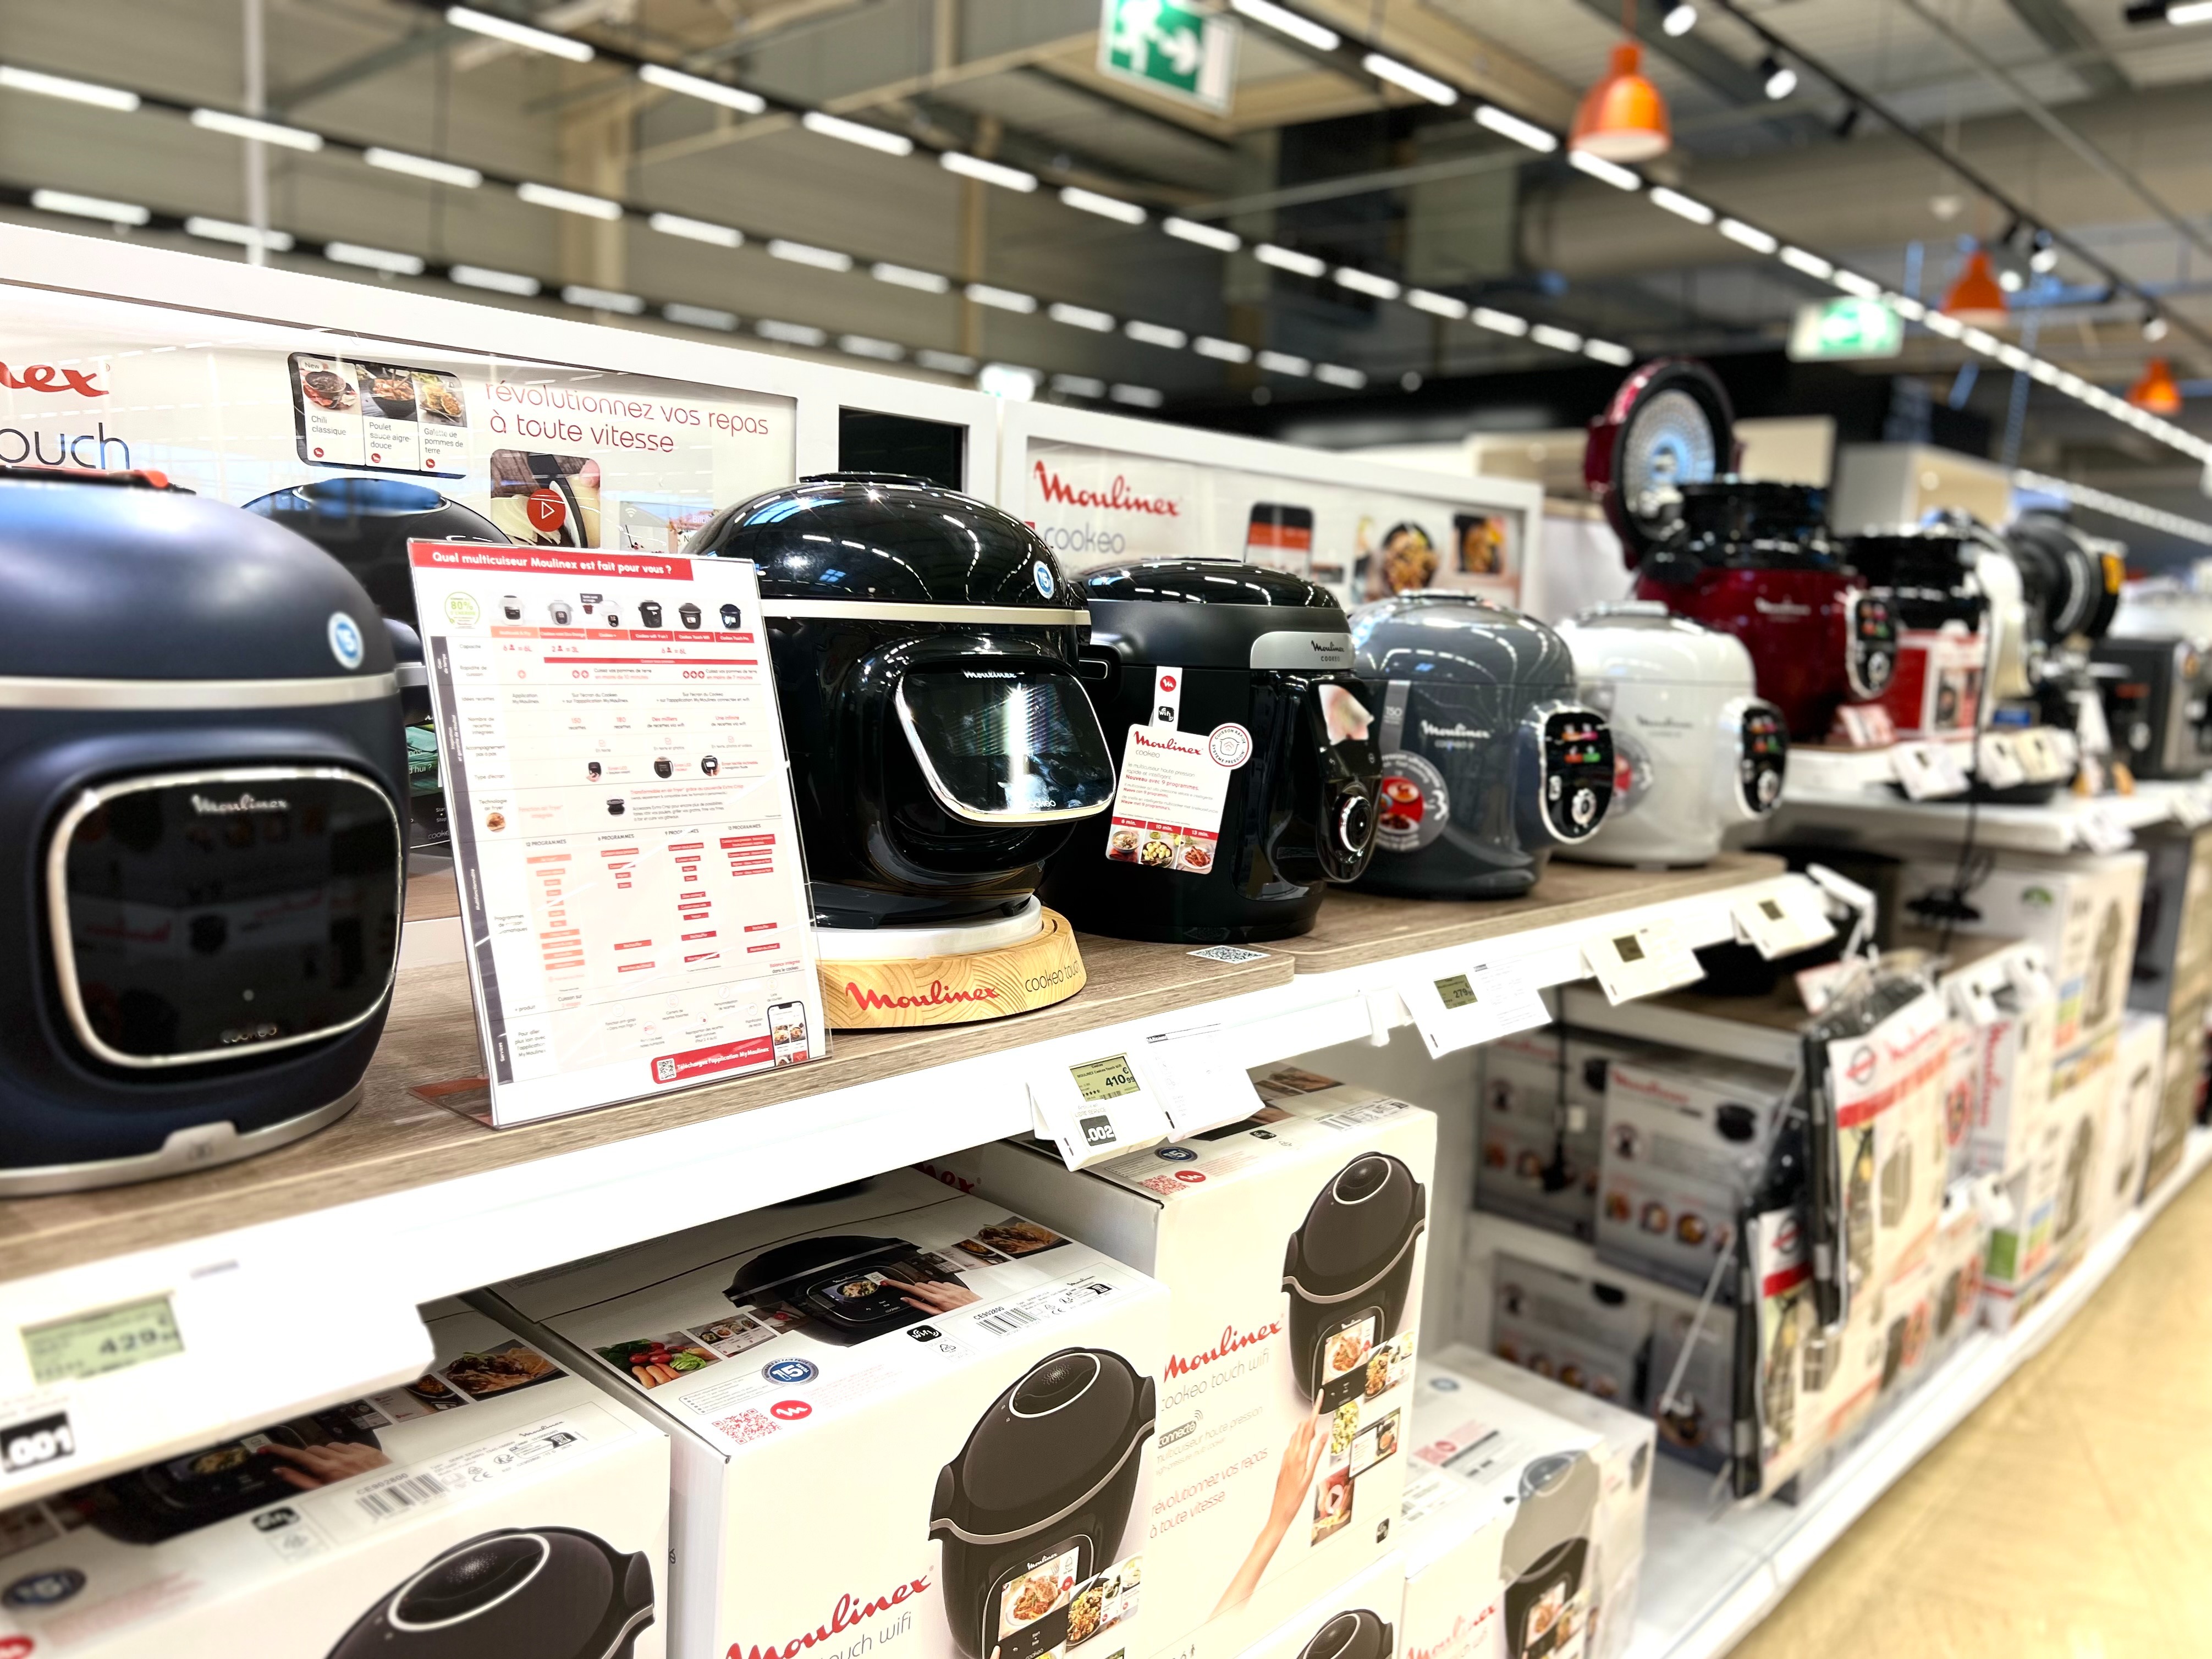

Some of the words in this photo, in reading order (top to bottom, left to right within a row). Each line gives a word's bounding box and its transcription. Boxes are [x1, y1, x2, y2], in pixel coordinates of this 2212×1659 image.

[486, 381, 652, 419] révolutionnez
[660, 406, 700, 427] vos
[709, 412, 768, 437] repas
[312, 427, 346, 436] classique
[370, 422, 392, 431] Poulet
[424, 429, 447, 437] Galette
[490, 414, 507, 434] à
[518, 415, 582, 444] toute
[591, 424, 674, 453] vitesse
[425, 439, 453, 448] pommes
[1033, 460, 1181, 518] Moulinex
[1045, 522, 1126, 555] cookeo
[432, 552, 459, 563] Quel
[462, 555, 527, 566] multicuiseur
[531, 558, 577, 569] Moulinex
[580, 560, 596, 570] est
[597, 561, 615, 571] fait
[618, 564, 640, 574] pour
[642, 565, 664, 574] vous
[666, 565, 672, 574] ?
[1311, 640, 1345, 653] Moulinex
[961, 670, 1017, 679] Moulinex
[1215, 729, 1234, 740] CUISSON
[1133, 731, 1203, 756] Moulinex
[1136, 749, 1160, 758] cookeo
[1166, 781, 1199, 791] programmes.
[1025, 969, 1064, 992] cookeo
[846, 980, 999, 1011] Moulinex
[1454, 988, 1468, 998] 279
[677, 1060, 708, 1071] Téléchargez
[1105, 1074, 1126, 1087] 410
[973, 1307, 1004, 1320] CE902800
[1164, 1320, 1283, 1384] Moulinex
[772, 1365, 803, 1380] 15
[1211, 1363, 1245, 1388] touch
[1249, 1348, 1269, 1371] wifi
[1152, 1473, 1219, 1517] révolutionnez
[1221, 1463, 1239, 1480] vos
[1241, 1447, 1269, 1471] repas
[1160, 1506, 1187, 1531] toute
[1190, 1491, 1226, 1519] vitesse
[1027, 1552, 1058, 1570] Moulinex
[879, 1611, 912, 1644] wifi
